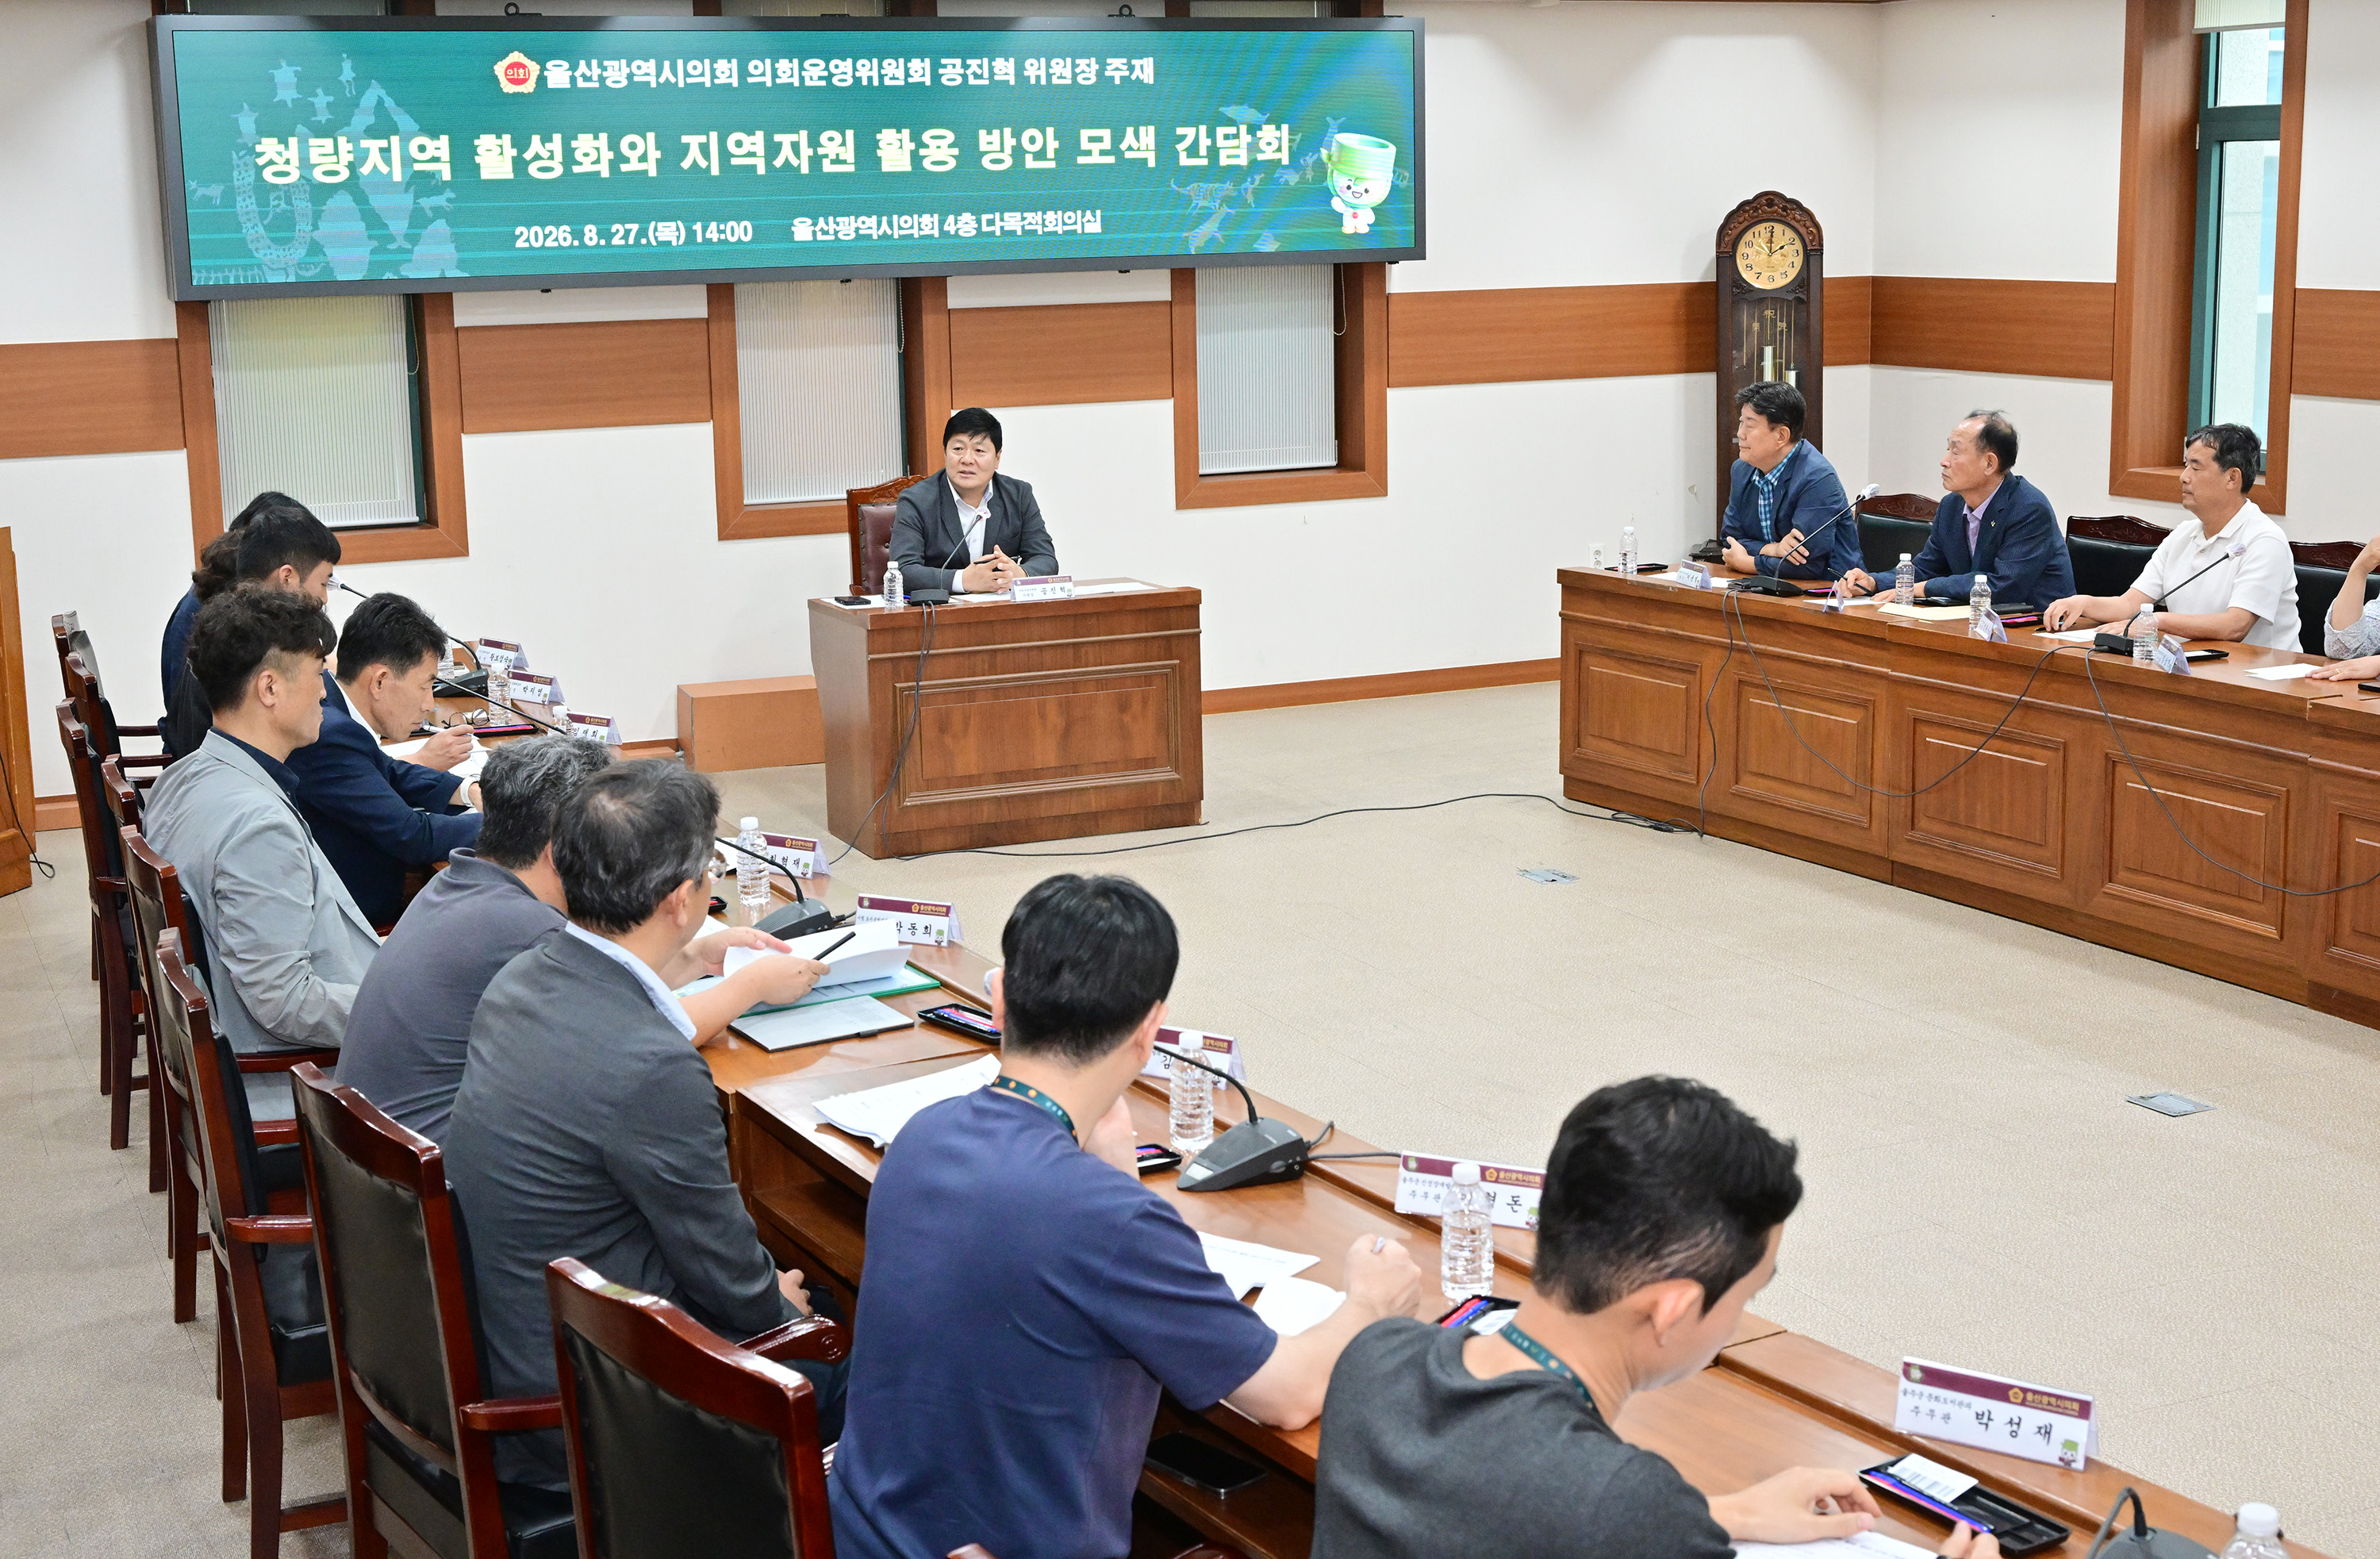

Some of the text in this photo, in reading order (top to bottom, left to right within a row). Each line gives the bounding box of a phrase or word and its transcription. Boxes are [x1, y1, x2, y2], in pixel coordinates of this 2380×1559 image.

[506, 67, 529, 79] 의회
[544, 57, 1154, 90] 울산광역시의회 의회운영위원회 공진혁 위원장 주재
[254, 124, 1290, 186] 청량지역 활성화와 지역자원 활용 방안 모색 간담회
[514, 225, 579, 249] 2026.
[692, 221, 753, 244] 14:00
[791, 214, 939, 242] 울산광역시의회
[944, 214, 977, 238] 4층
[981, 210, 1102, 237] 다목적회의실
[1764, 225, 1775, 234] 12
[1745, 240, 1753, 248] 10
[1780, 271, 1788, 279] 5
[2025, 1392, 2079, 1411] 울산광역시의회
[1975, 1409, 2053, 1446] 박성재
